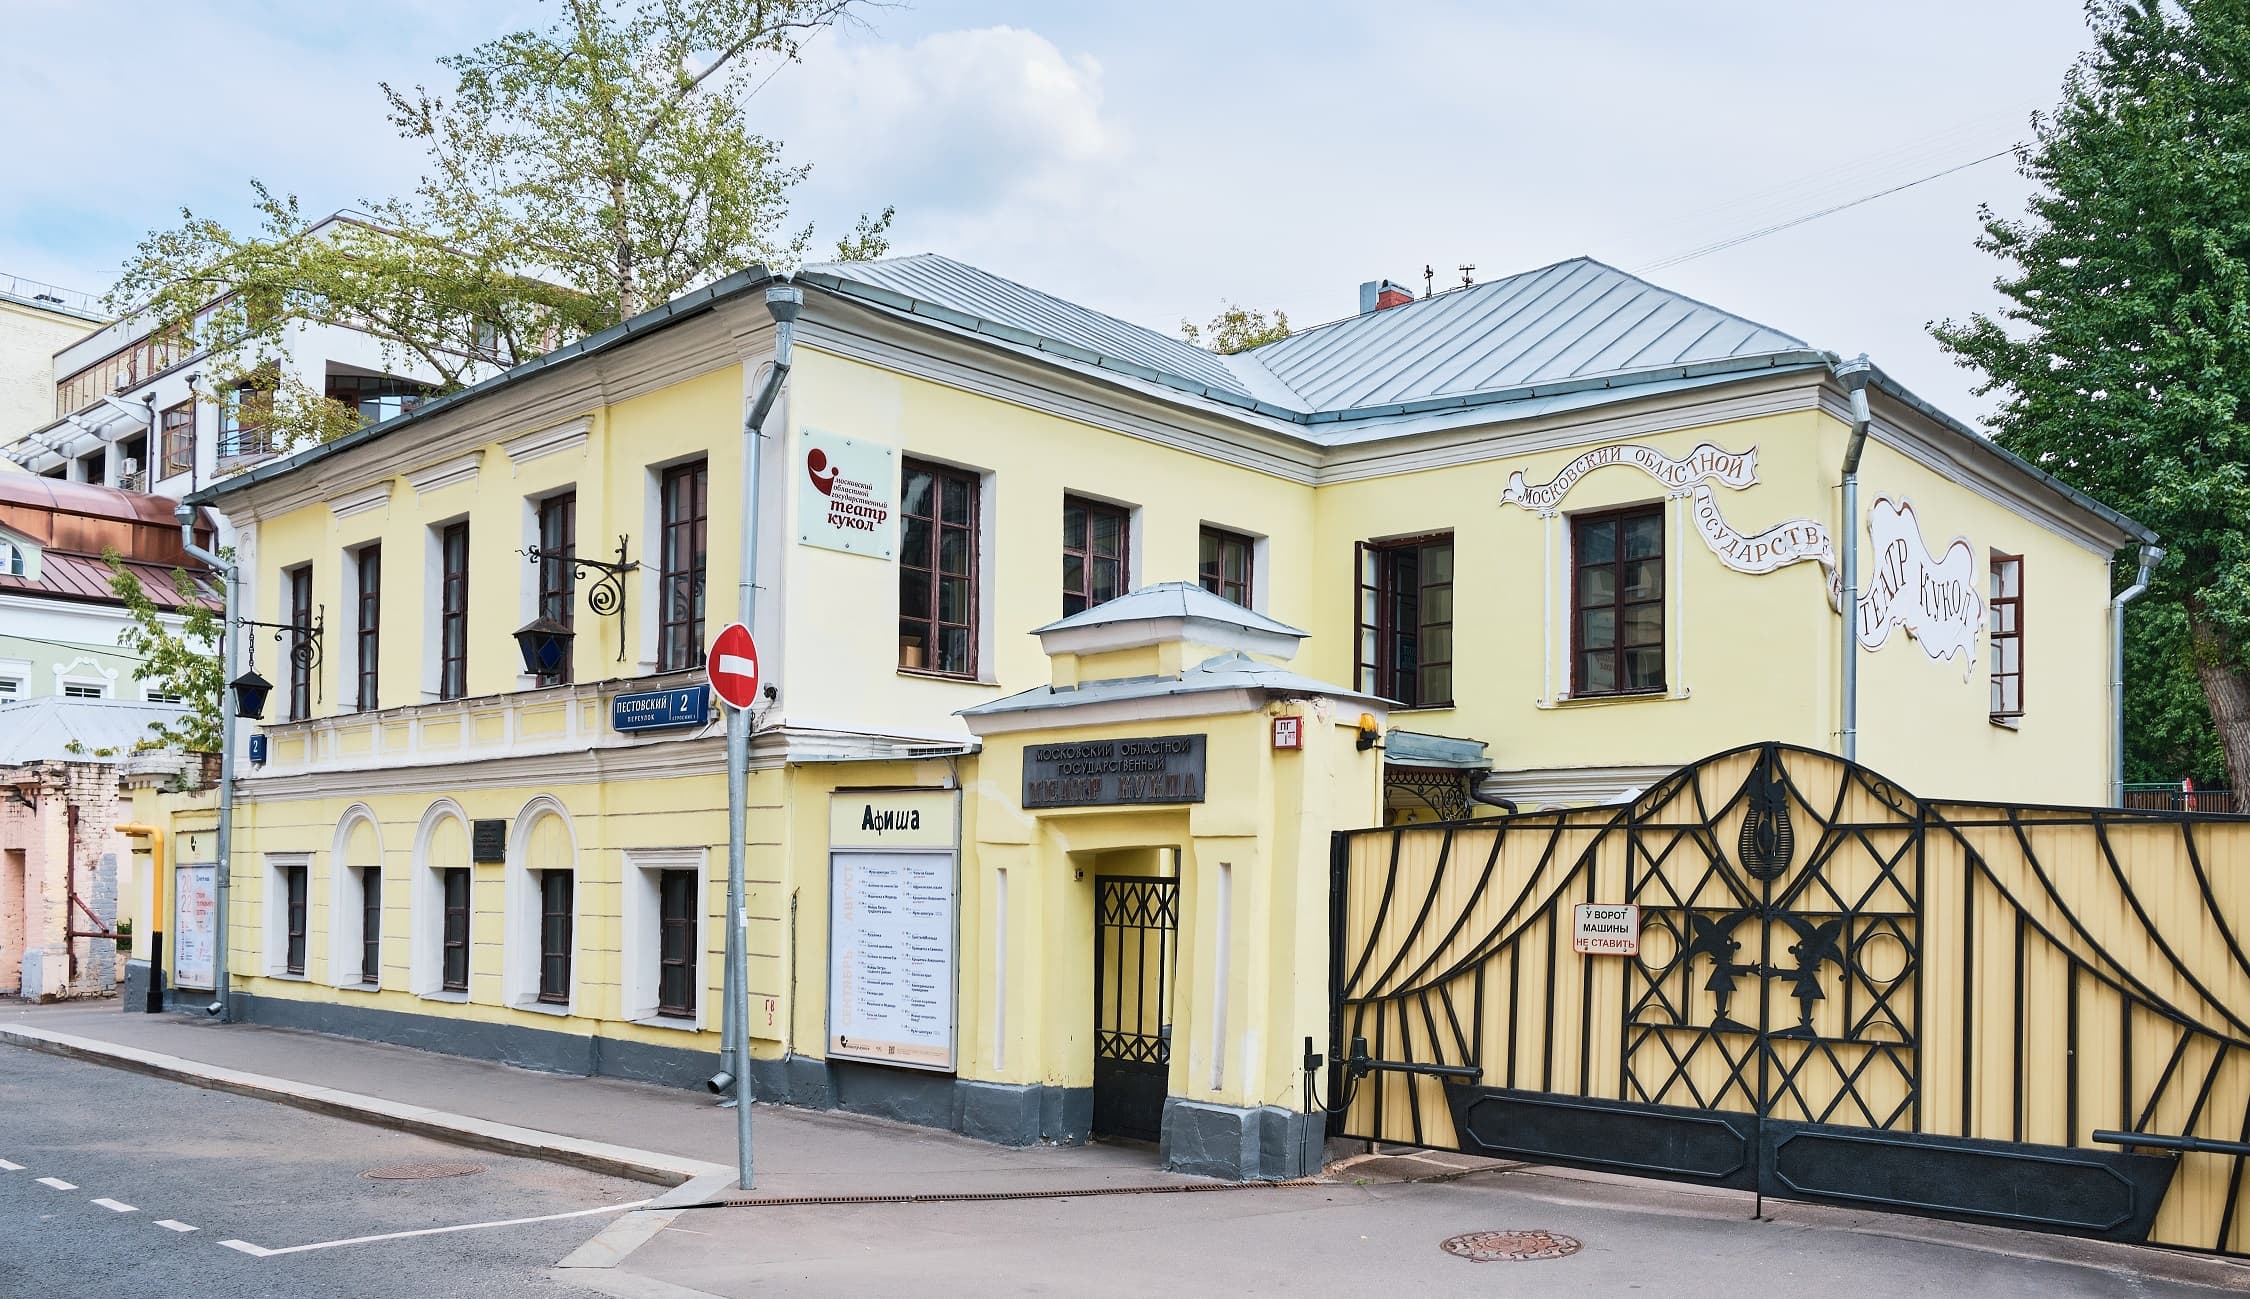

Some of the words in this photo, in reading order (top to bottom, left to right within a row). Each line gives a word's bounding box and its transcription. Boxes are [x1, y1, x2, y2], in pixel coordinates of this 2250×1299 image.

[1518, 446, 1622, 505] МОСКОВСКИЙ
[1635, 449, 1744, 483] ОБЛАСТНОЙ
[833, 485, 869, 498] областной
[834, 478, 873, 491] московский
[831, 493, 888, 509] государственный
[830, 500, 888, 525] театр
[827, 512, 875, 532] кукол
[1859, 538, 1908, 635] ТЕАТР
[1920, 562, 1971, 626] КУКОЛ
[616, 696, 667, 713] ПЕСТОВСКИЙ
[680, 694, 688, 712] 2
[627, 713, 655, 723] ПЕРЕУЛОК
[1280, 722, 1292, 731] ПГ
[253, 740, 258, 752] 2
[1036, 743, 1113, 761] МОСКОВСКИЙ
[1120, 739, 1191, 756] ОБЛАСТНОЙ
[1057, 756, 1165, 775] ГОСУДАРСТВЕННЫЙ
[862, 804, 920, 836] Афиша
[1586, 910, 1592, 919] У
[1594, 910, 1627, 919] ВОРОТ
[1583, 924, 1629, 933] МАШИНЫ
[1576, 938, 1589, 946] НЕ
[1592, 938, 1635, 948] СТАВИТЬ
